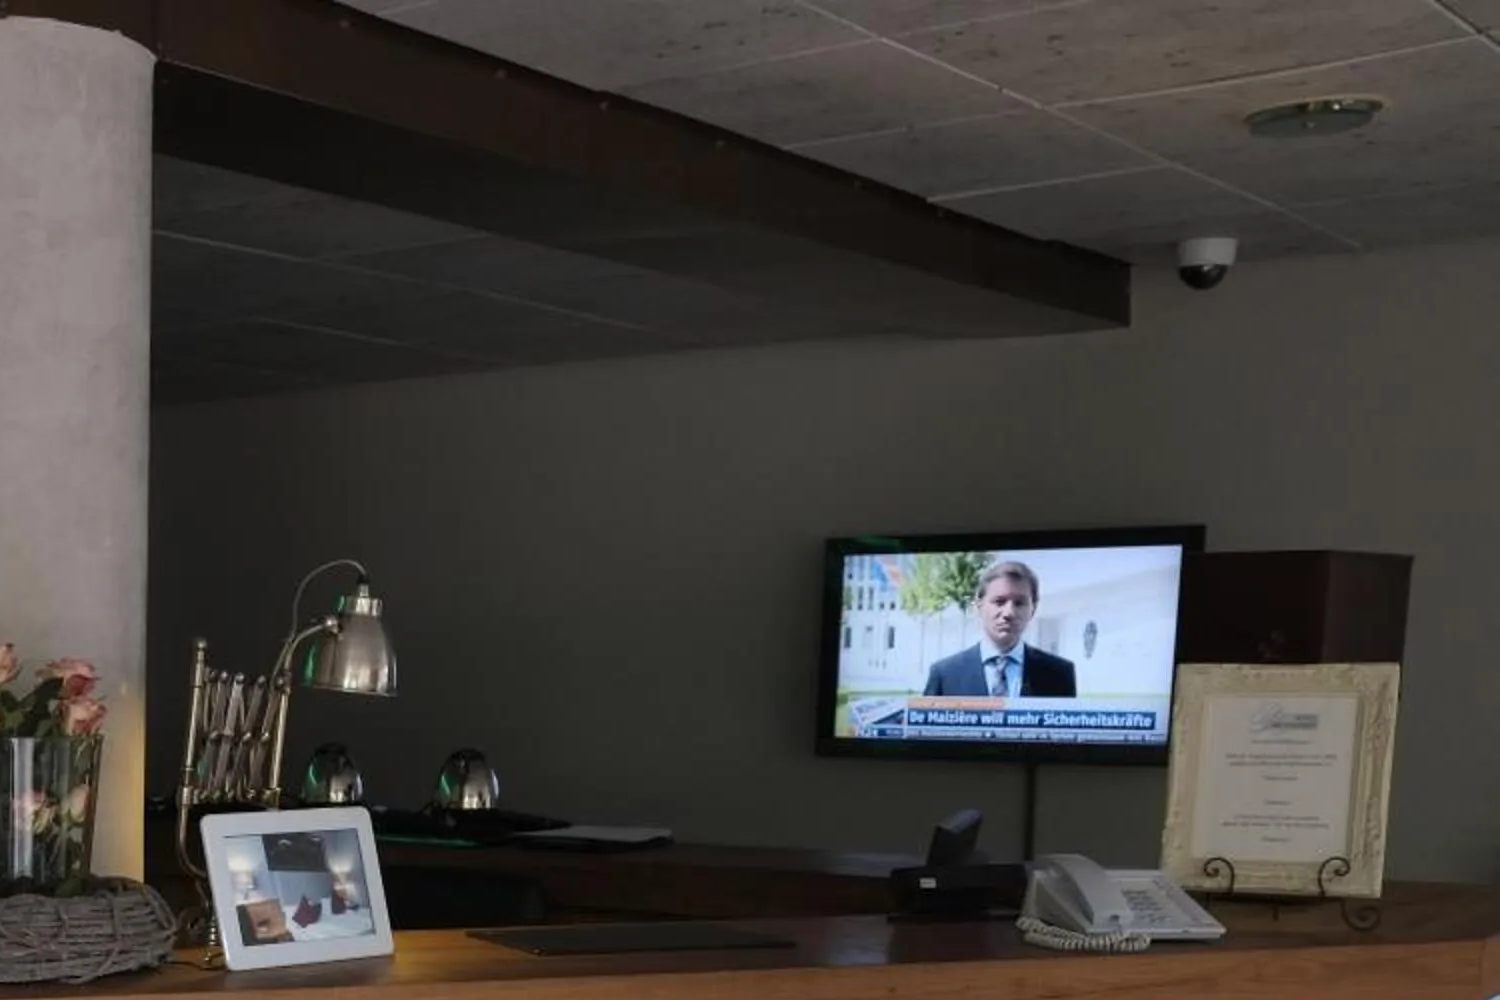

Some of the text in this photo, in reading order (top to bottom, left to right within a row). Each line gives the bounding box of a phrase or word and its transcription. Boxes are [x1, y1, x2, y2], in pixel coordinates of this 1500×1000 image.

[910, 710, 1152, 727] De Maizière will mehr Sicherheitskräfte
